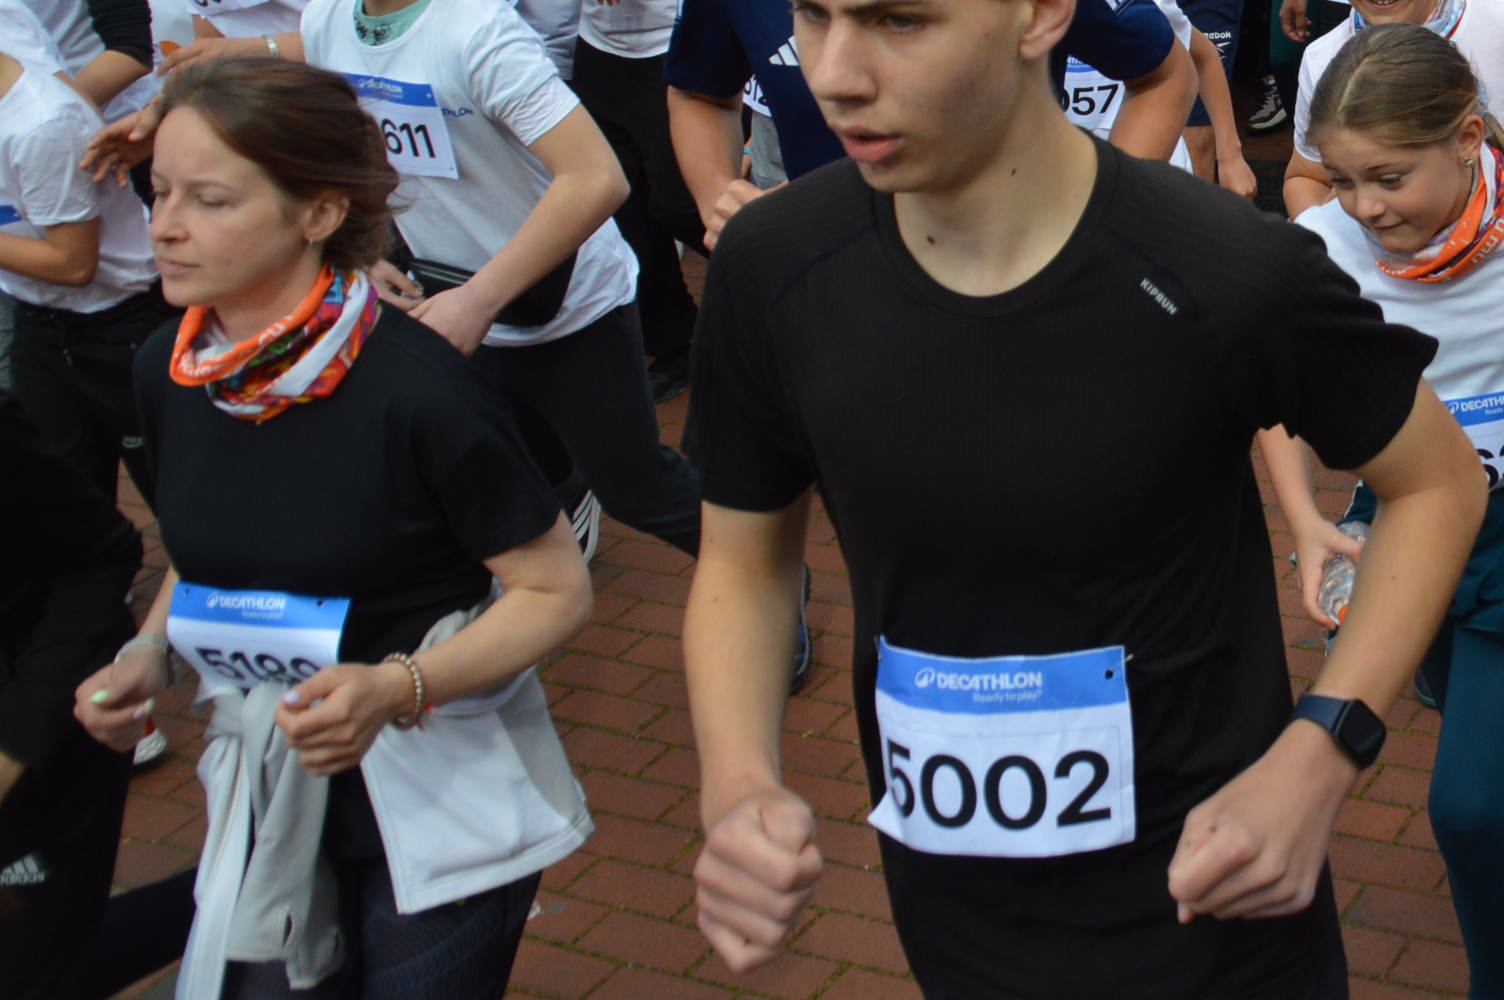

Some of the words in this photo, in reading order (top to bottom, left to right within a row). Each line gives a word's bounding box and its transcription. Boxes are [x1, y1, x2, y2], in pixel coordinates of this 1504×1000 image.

[1139, 276, 1178, 316] KIPRUN
[936, 671, 1043, 691] DECATHLON
[972, 692, 1004, 704] Ready
[1005, 691, 1015, 702] to
[1016, 688, 1043, 703] play?
[886, 737, 1112, 832] 5002
